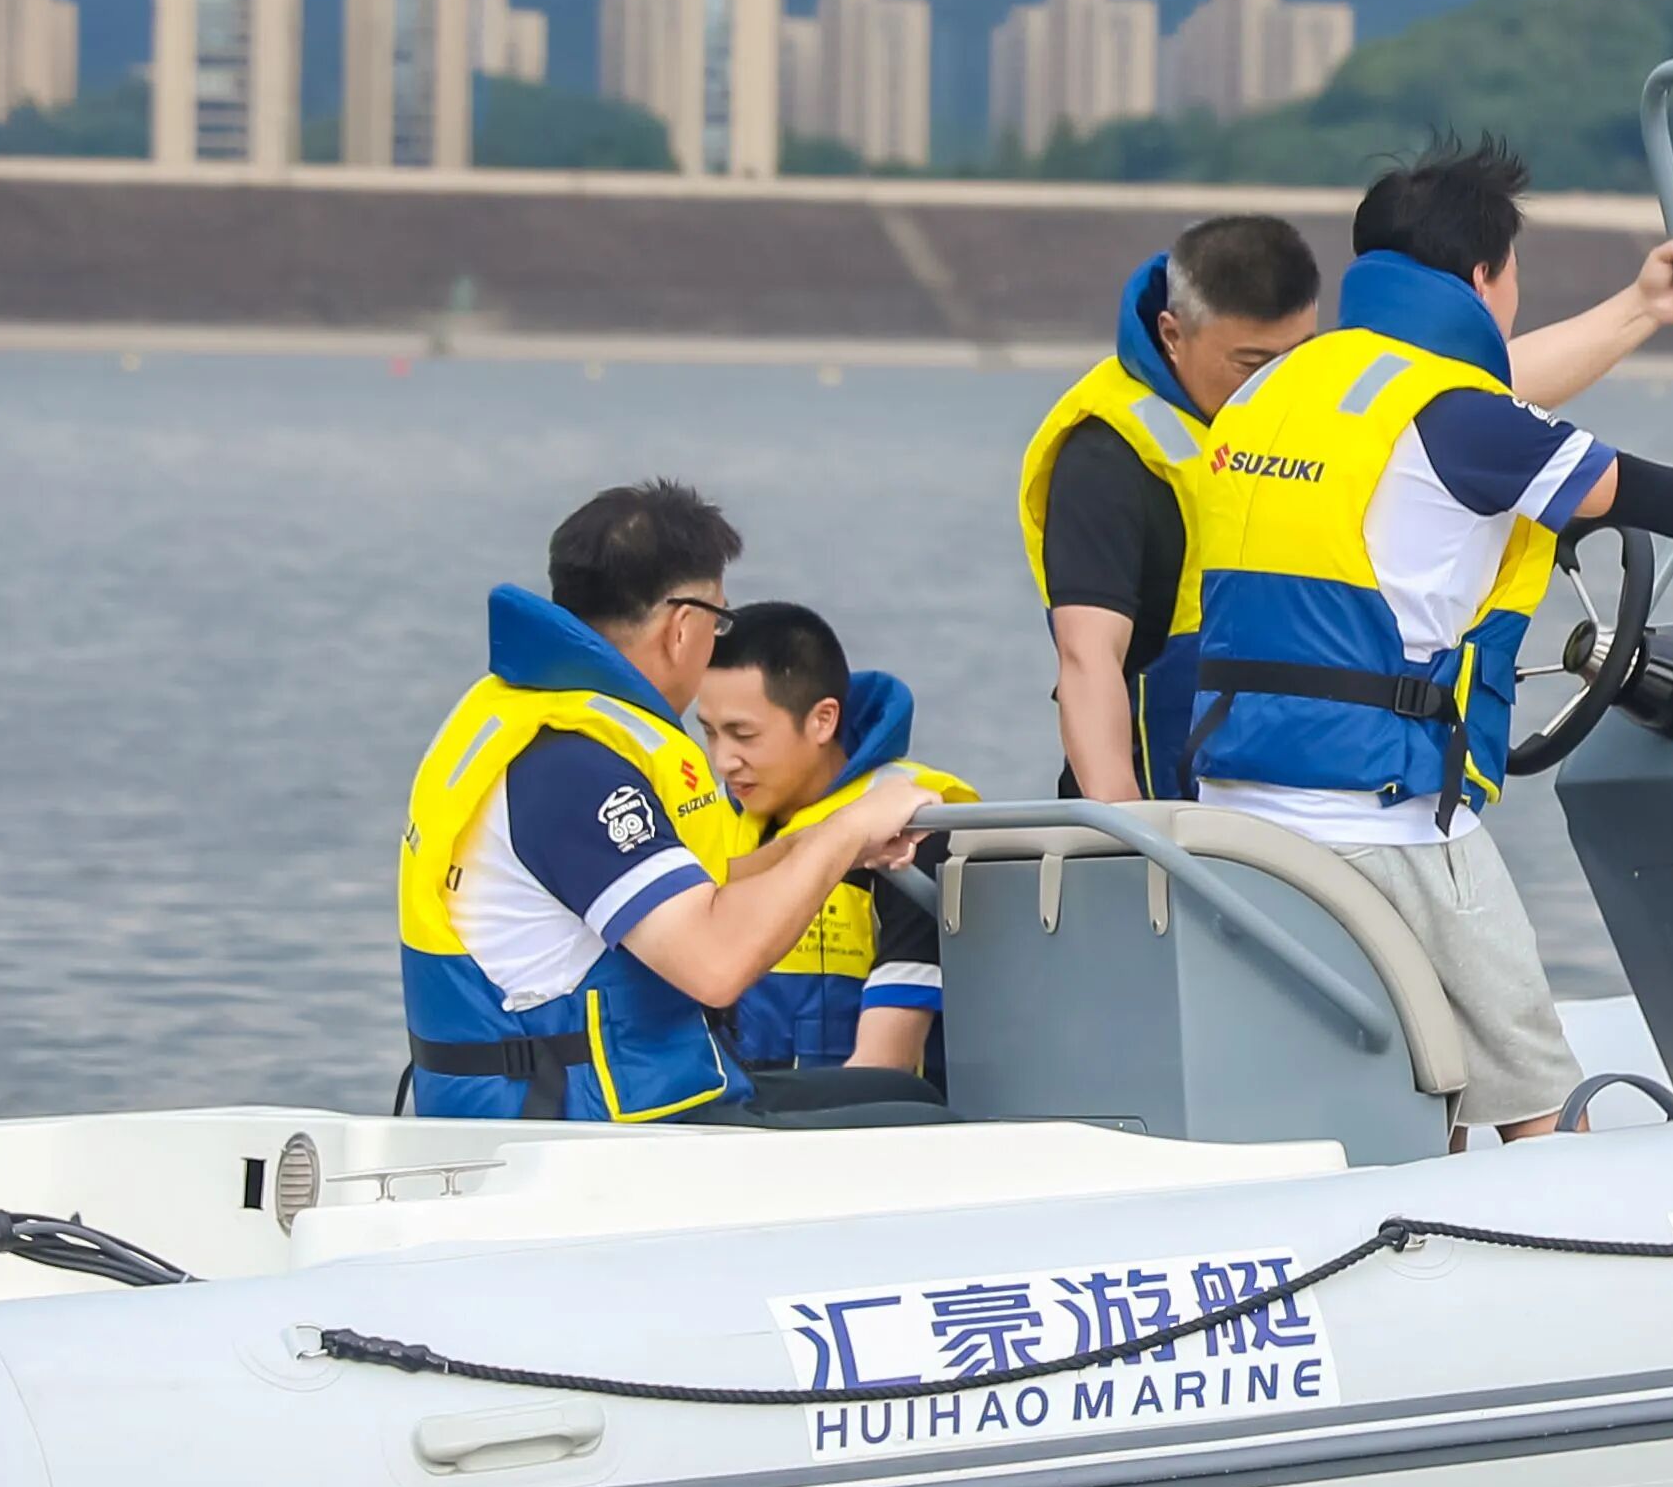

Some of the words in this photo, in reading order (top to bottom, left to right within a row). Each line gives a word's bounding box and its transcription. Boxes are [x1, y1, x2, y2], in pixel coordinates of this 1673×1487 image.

[1229, 451, 1325, 483] SUZUKI
[677, 791, 717, 818] SUZUKI
[608, 813, 644, 844] 60
[790, 1257, 1316, 1391] 汇豪游艇
[816, 1386, 1049, 1451] HUIHAO
[1072, 1358, 1322, 1421] MARINE
